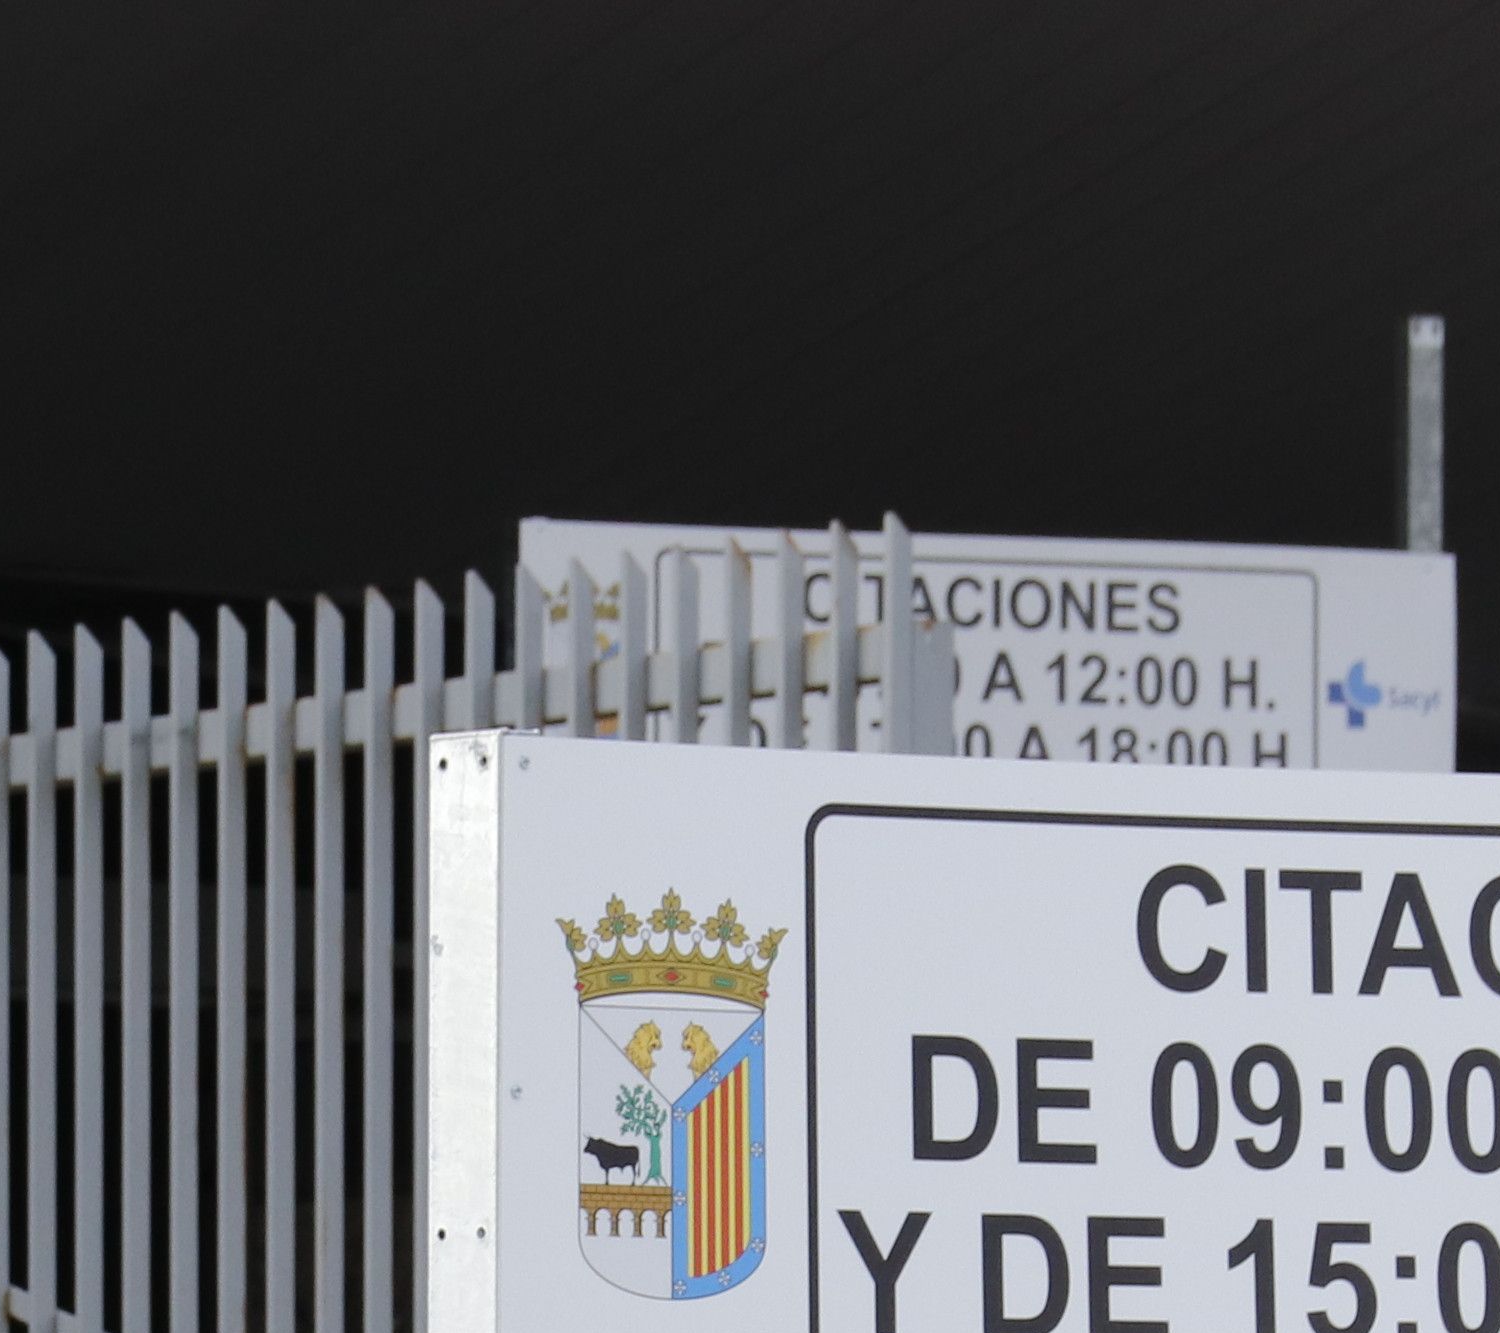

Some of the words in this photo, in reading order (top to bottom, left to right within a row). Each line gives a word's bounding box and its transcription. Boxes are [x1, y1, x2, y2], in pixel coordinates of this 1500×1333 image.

[804, 571, 1182, 634] CTACIONES
[983, 652, 1023, 704] A
[1046, 653, 1199, 707] 12:00
[1222, 658, 1276, 711] H.
[910, 1033, 1098, 1165] DE
